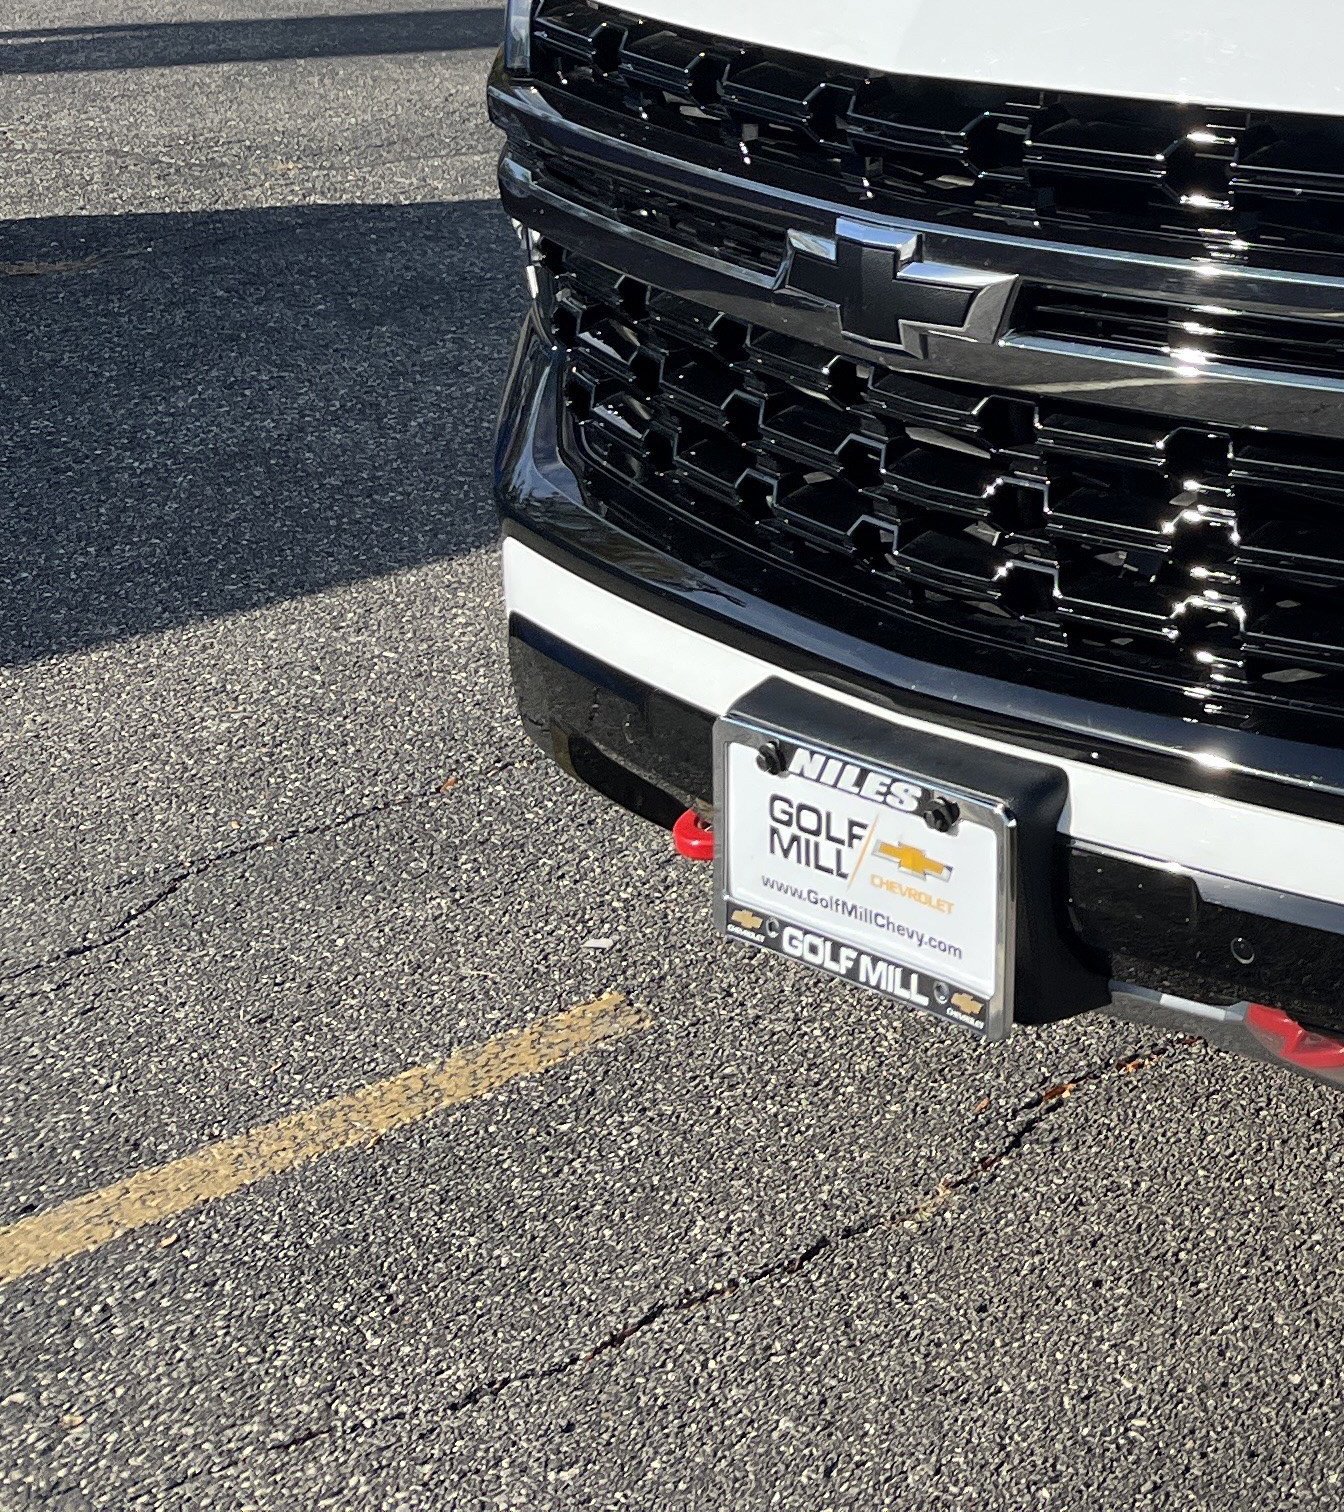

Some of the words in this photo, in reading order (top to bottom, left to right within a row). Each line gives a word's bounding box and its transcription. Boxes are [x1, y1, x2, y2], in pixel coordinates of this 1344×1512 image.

[787, 749, 922, 813] NILES
[768, 793, 868, 849] GOLF
[768, 827, 853, 881] MILL
[761, 874, 963, 960] www.GolfMillChevy.com
[870, 873, 955, 916] CHEVROLET
[782, 926, 859, 975] GOLF
[858, 957, 929, 1006] MILL
